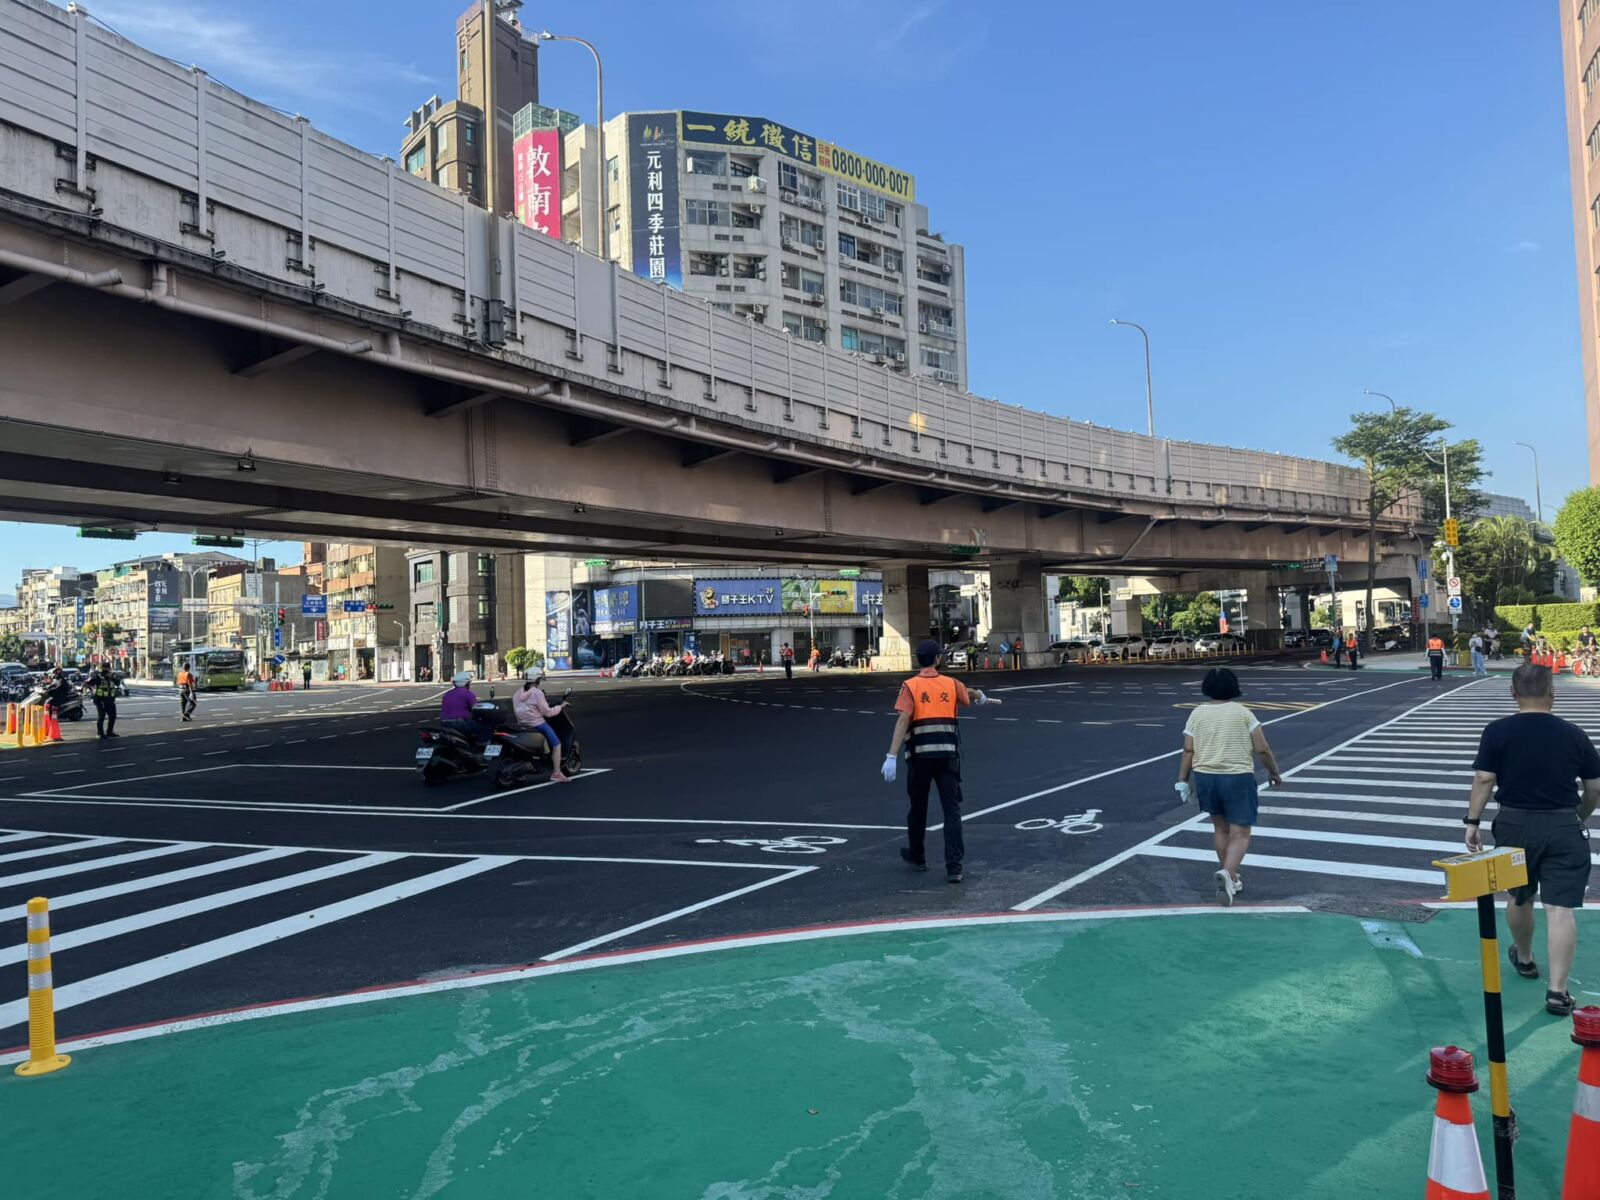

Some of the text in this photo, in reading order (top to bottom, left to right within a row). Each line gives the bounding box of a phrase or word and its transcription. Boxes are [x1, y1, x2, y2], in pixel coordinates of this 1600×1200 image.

[647, 150, 665, 279] 元利四季莊園
